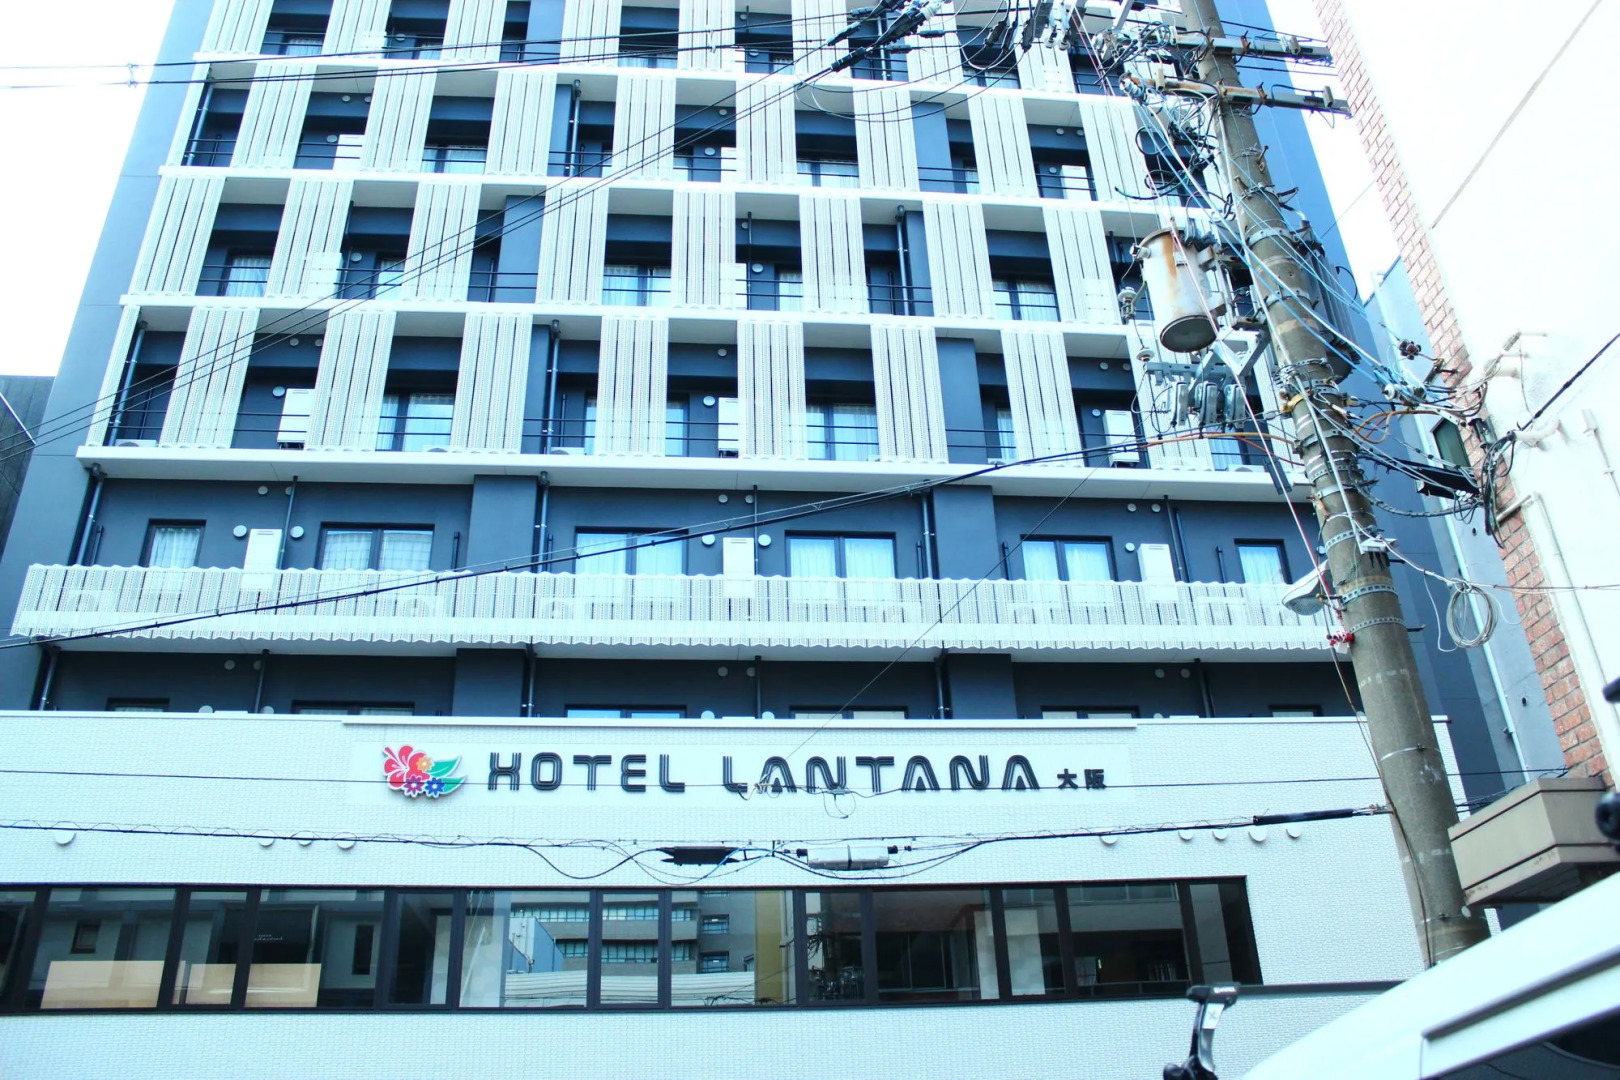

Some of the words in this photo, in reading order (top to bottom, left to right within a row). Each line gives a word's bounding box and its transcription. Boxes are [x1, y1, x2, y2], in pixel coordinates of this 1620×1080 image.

[488, 752, 685, 793] HOTEL
[722, 755, 1040, 793] LANTANA
[1057, 768, 1106, 790] 大阪
